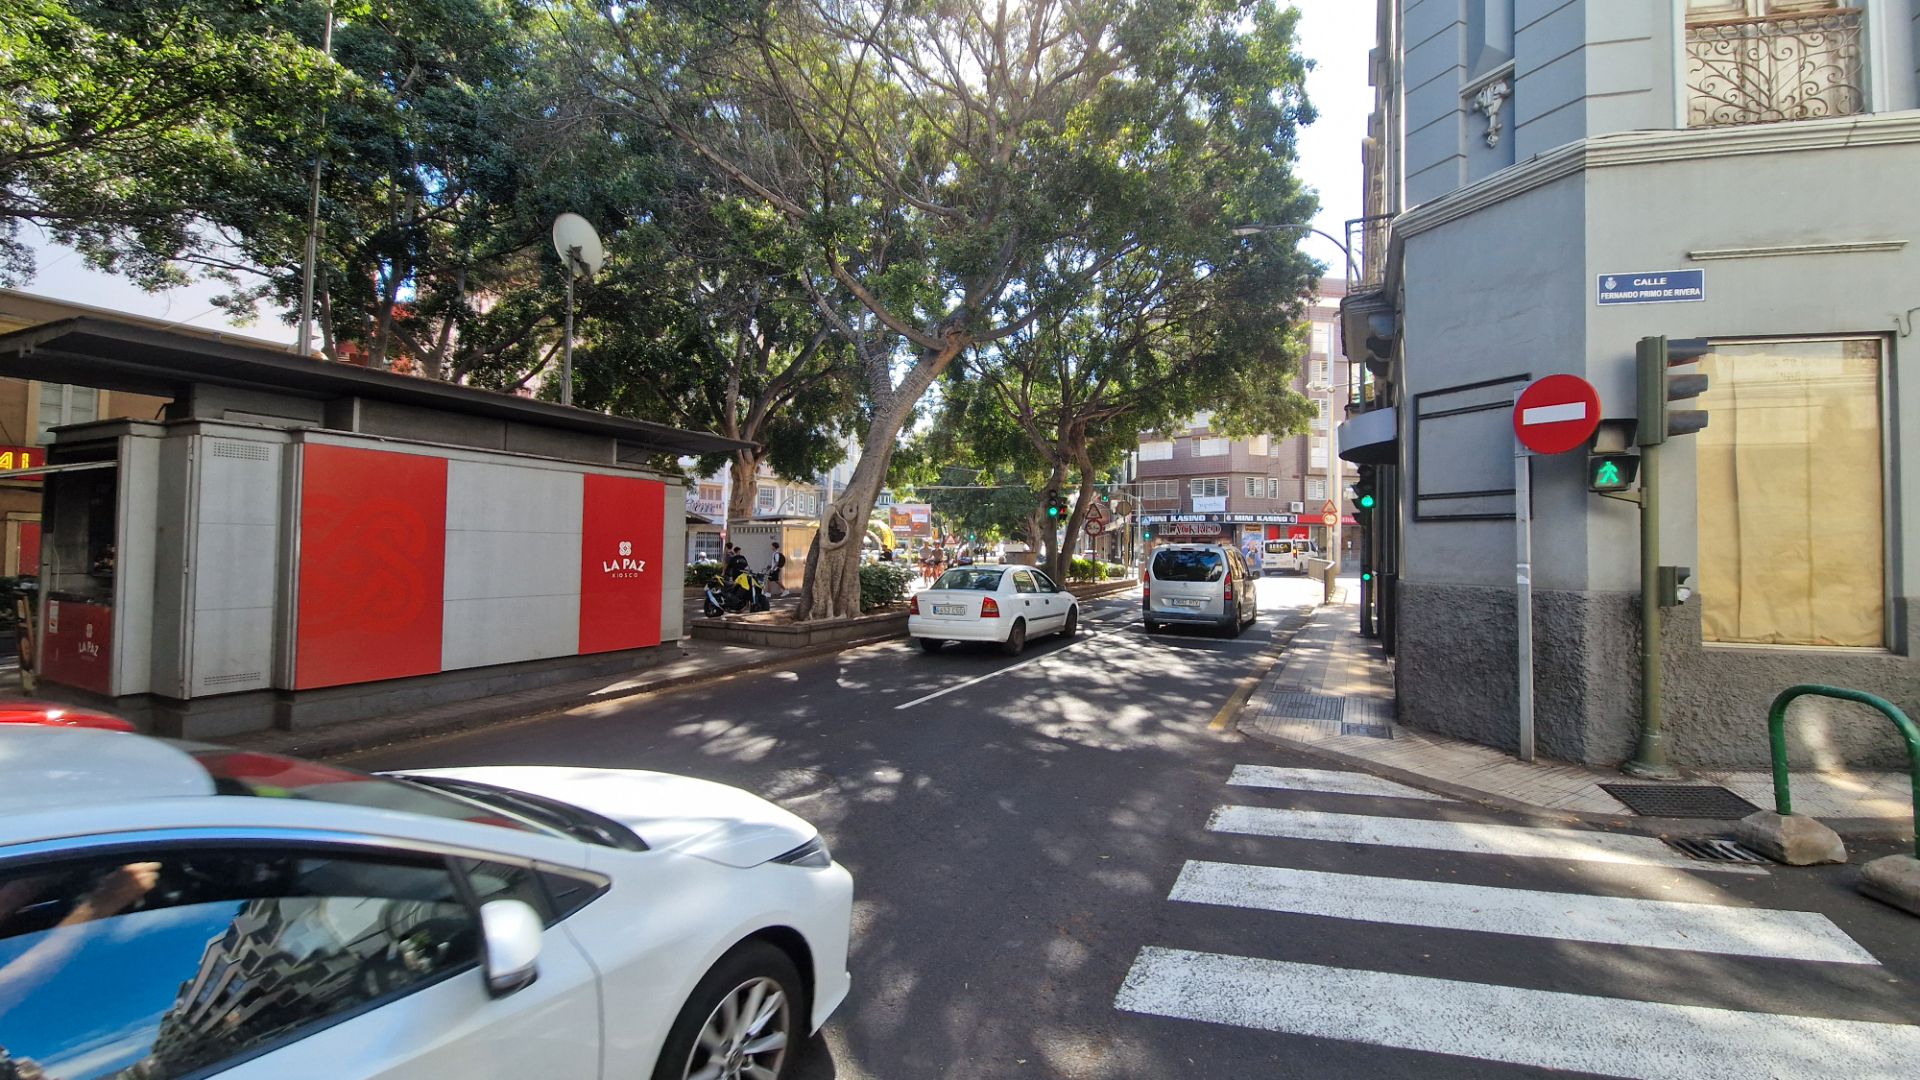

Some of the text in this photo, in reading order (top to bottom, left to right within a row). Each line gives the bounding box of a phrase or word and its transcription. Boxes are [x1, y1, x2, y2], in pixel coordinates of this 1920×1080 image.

[1633, 277, 1668, 286] CALLE
[1601, 287, 1701, 299] FERNANDO PRIMO DE RIVERA
[603, 558, 646, 573] LA PAZ
